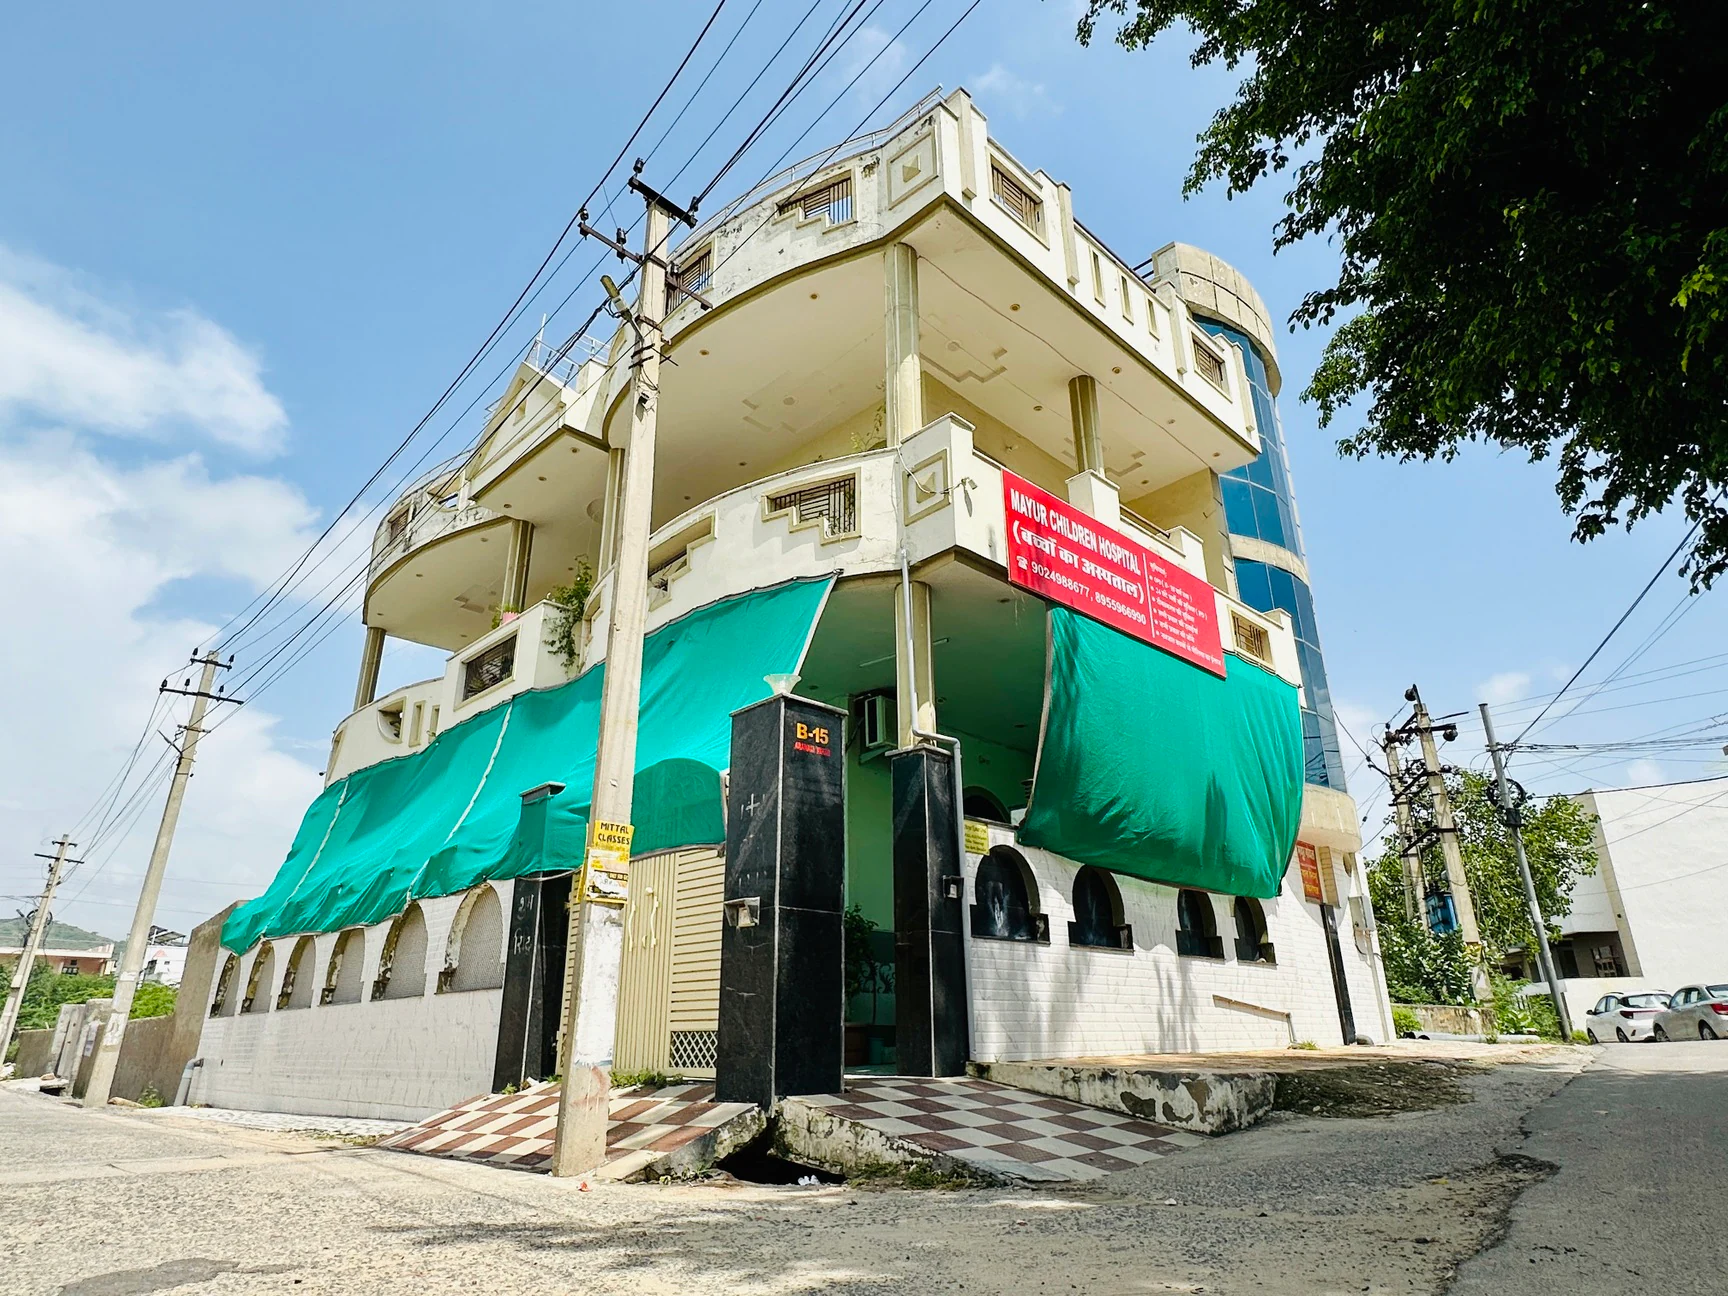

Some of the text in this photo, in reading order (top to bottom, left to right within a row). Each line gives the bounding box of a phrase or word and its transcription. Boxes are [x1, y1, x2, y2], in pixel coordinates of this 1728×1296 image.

[1010, 488, 1141, 576] MAYUR CHILDREN HOSPITAL
[1057, 546, 1079, 569] का
[796, 722, 829, 745] B-15
[598, 833, 630, 845] CLASSES
[600, 822, 629, 834] MITTAL
